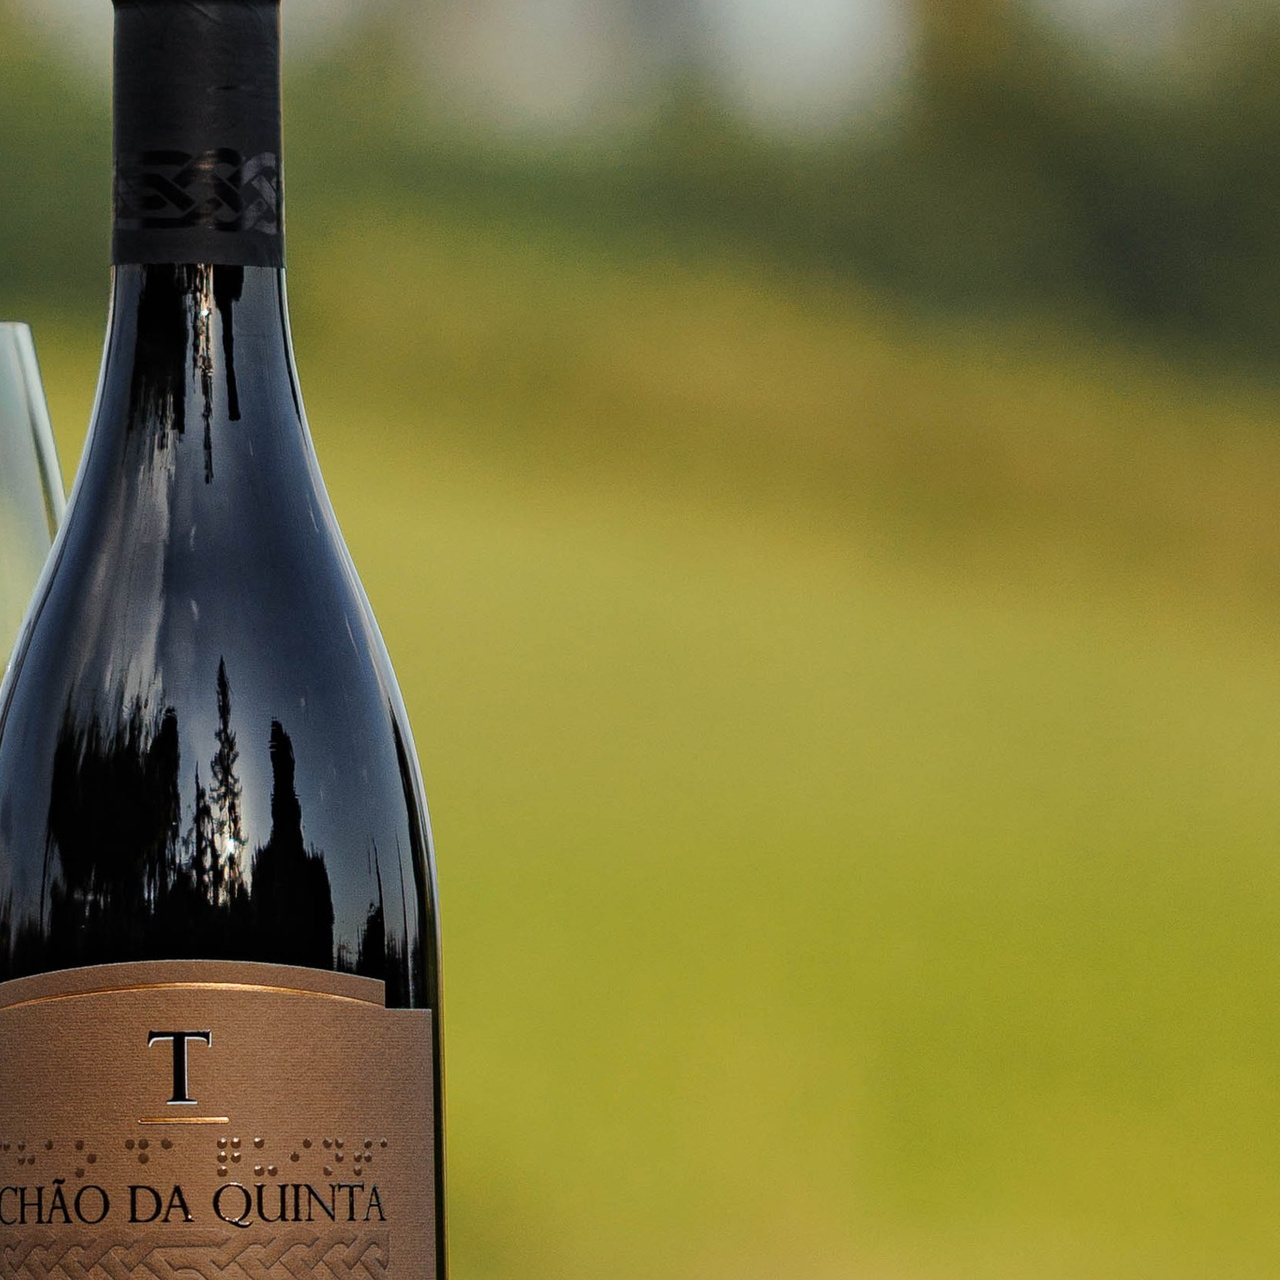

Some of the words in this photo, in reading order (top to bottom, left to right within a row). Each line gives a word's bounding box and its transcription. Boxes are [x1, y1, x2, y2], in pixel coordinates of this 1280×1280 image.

[147, 1029, 212, 1105] T
[127, 1184, 196, 1223] DA
[211, 1181, 388, 1229] QUINTA
